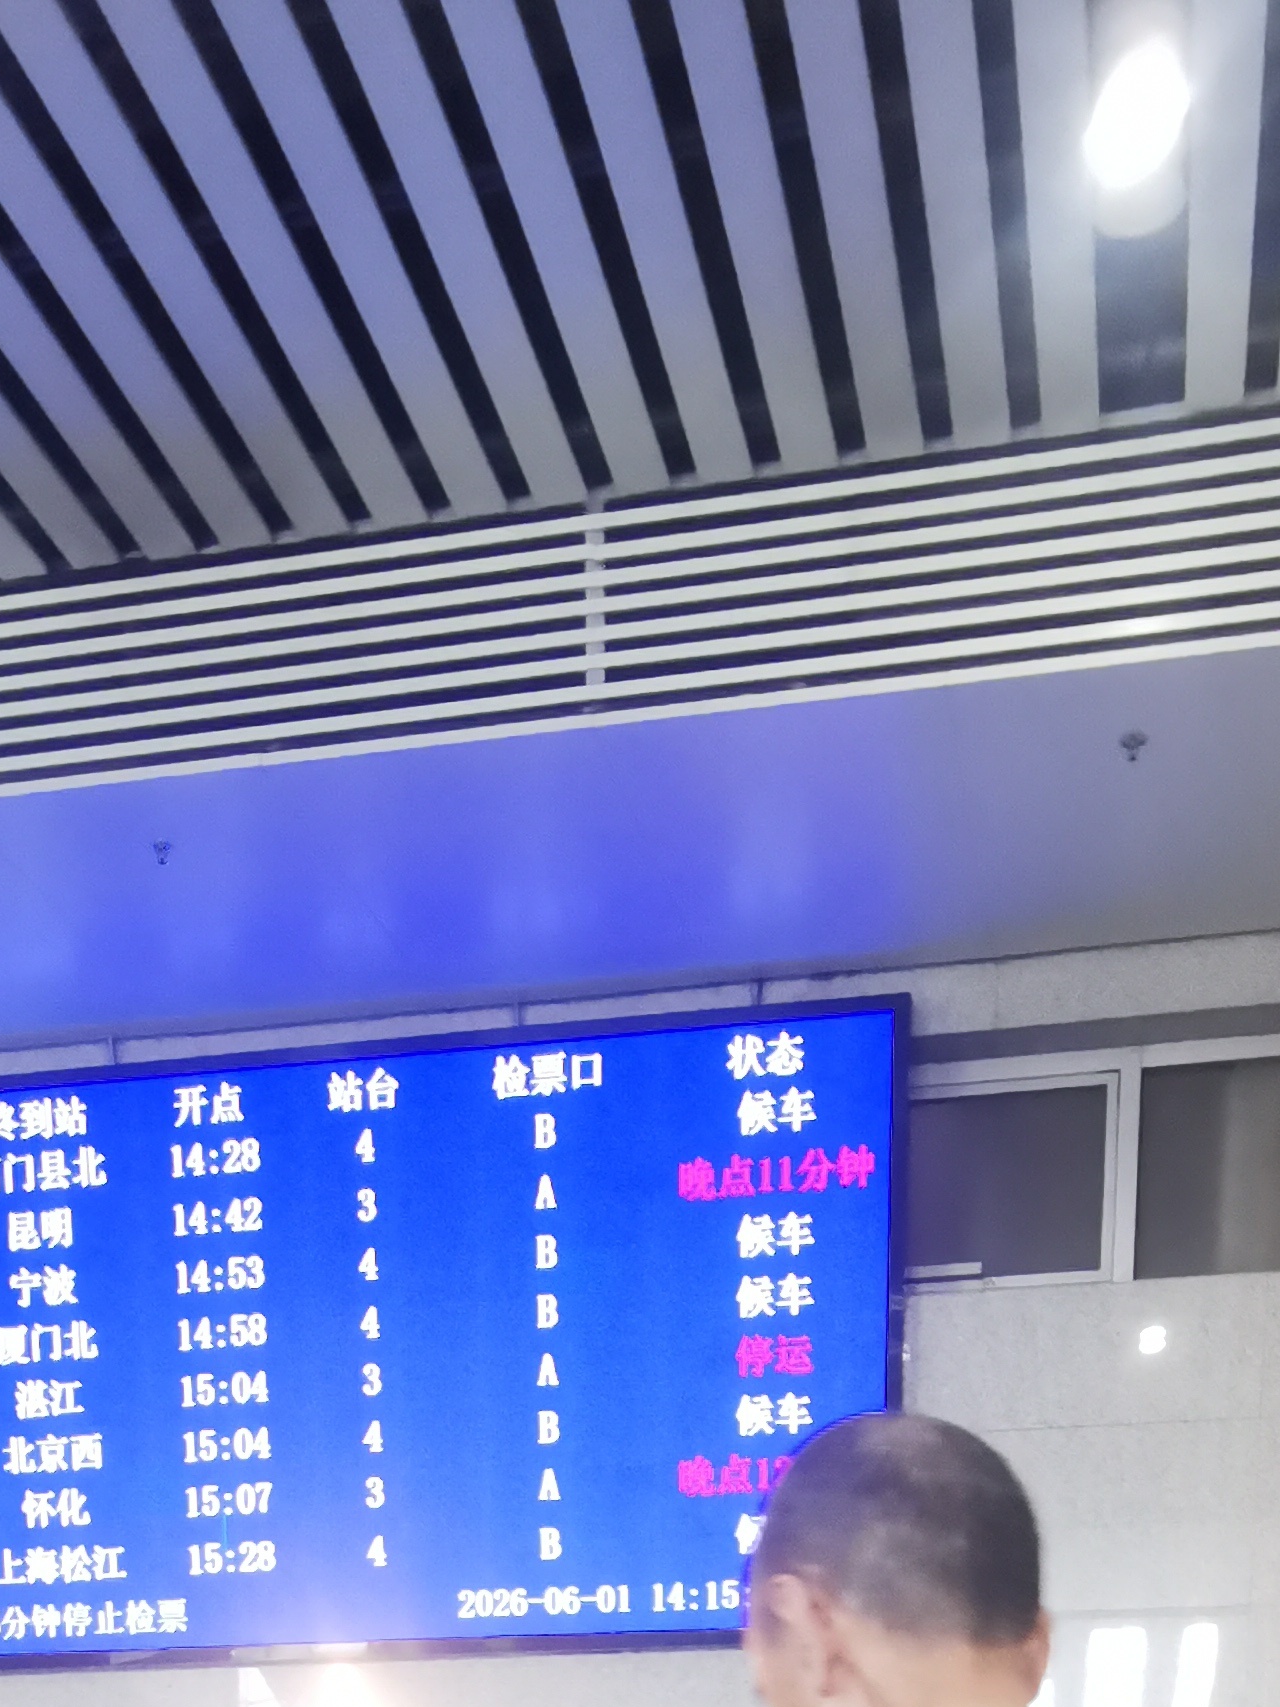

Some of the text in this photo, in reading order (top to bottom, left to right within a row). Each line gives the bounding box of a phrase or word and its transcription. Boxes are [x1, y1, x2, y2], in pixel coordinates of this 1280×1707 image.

[174, 1082, 244, 1127] 开点
[328, 1068, 398, 1112] 站台
[492, 1052, 602, 1099] 检票口
[726, 1032, 804, 1079] 状态
[171, 1138, 260, 1178] 14:28
[355, 1129, 375, 1162] 4
[534, 1114, 556, 1148] B
[737, 1087, 816, 1135] 候车
[8, 1208, 72, 1251] 昆明
[173, 1197, 262, 1236] 14:42
[358, 1188, 377, 1222] 3
[535, 1175, 557, 1209] A
[679, 1145, 874, 1201] 晚点11分钟
[9, 1264, 78, 1307] 宁波
[176, 1256, 265, 1294] 14:53
[359, 1248, 378, 1280] 4
[536, 1235, 557, 1268] B
[736, 1212, 815, 1258] 候车
[178, 1313, 267, 1351] 14:58
[360, 1306, 380, 1338] 4
[537, 1294, 558, 1328] B
[736, 1273, 814, 1318] 候车
[15, 1380, 84, 1420] 湛江
[181, 1371, 269, 1407] 15:04
[362, 1363, 382, 1396] 3
[537, 1353, 559, 1386] A
[735, 1334, 814, 1377] 停运
[2, 1433, 102, 1474] 北京西
[183, 1427, 271, 1463] 15:04
[362, 1420, 383, 1452] 4
[538, 1411, 560, 1444] B
[736, 1392, 813, 1436] 候车
[21, 1488, 91, 1528] 怀化
[185, 1482, 272, 1518] 15:07
[365, 1477, 385, 1508] 3
[538, 1468, 560, 1500] A
[187, 1540, 277, 1576] 15:28
[365, 1535, 387, 1568] 4
[539, 1527, 562, 1560] B
[457, 1585, 630, 1618] 2026-06-01
